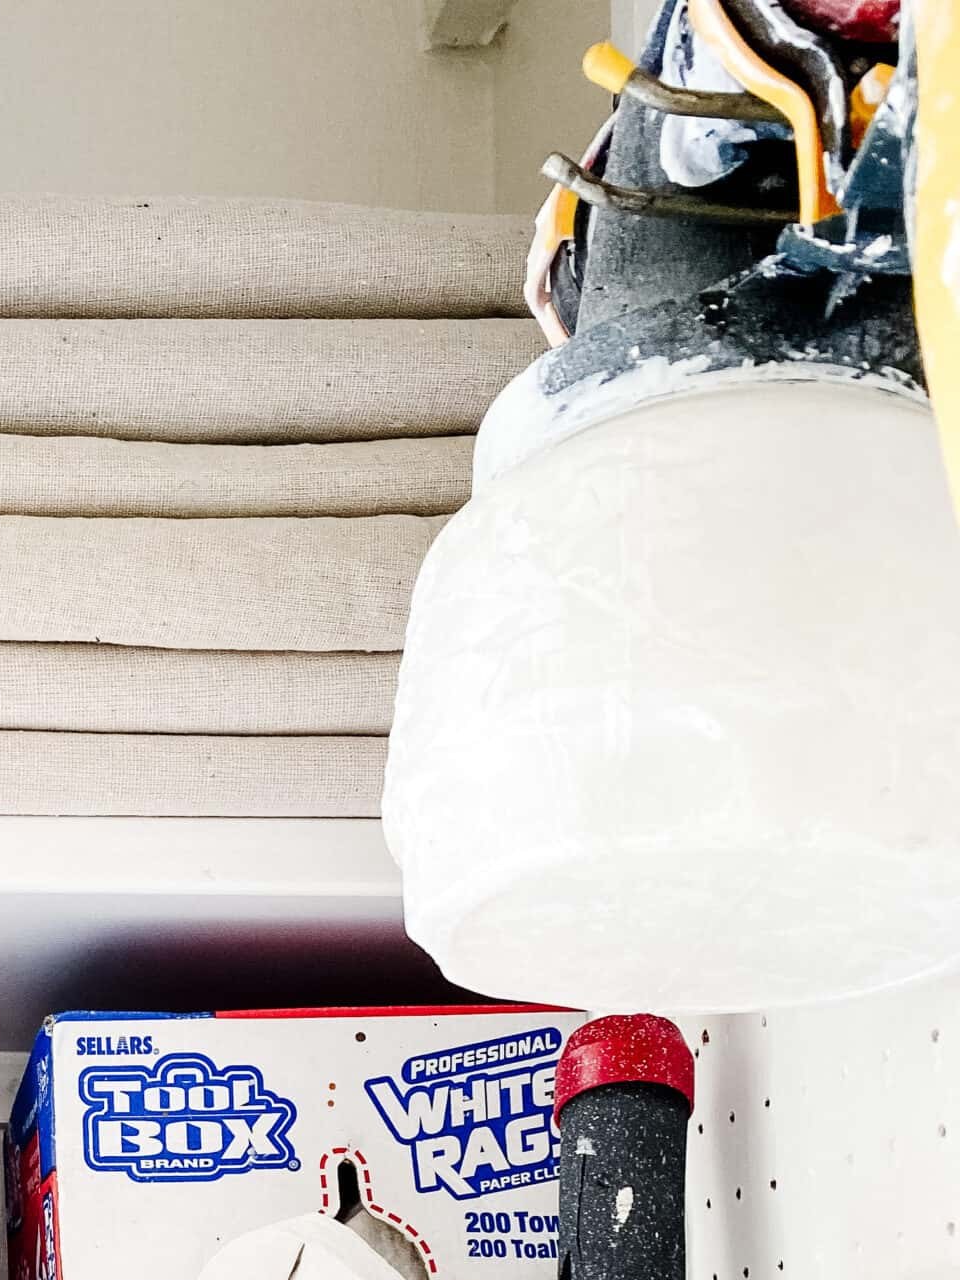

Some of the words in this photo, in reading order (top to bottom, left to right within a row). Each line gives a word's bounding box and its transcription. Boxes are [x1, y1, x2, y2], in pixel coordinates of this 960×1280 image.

[76, 1036, 153, 1056] SELLARS
[410, 1033, 557, 1080] PROFESSIONAL
[97, 1113, 284, 1160] BOX
[140, 1158, 214, 1170] BRAND
[480, 1172, 532, 1192] PAPER
[465, 1211, 511, 1233] 200
[513, 1211, 559, 1233] Tow
[467, 1239, 509, 1258] 200
